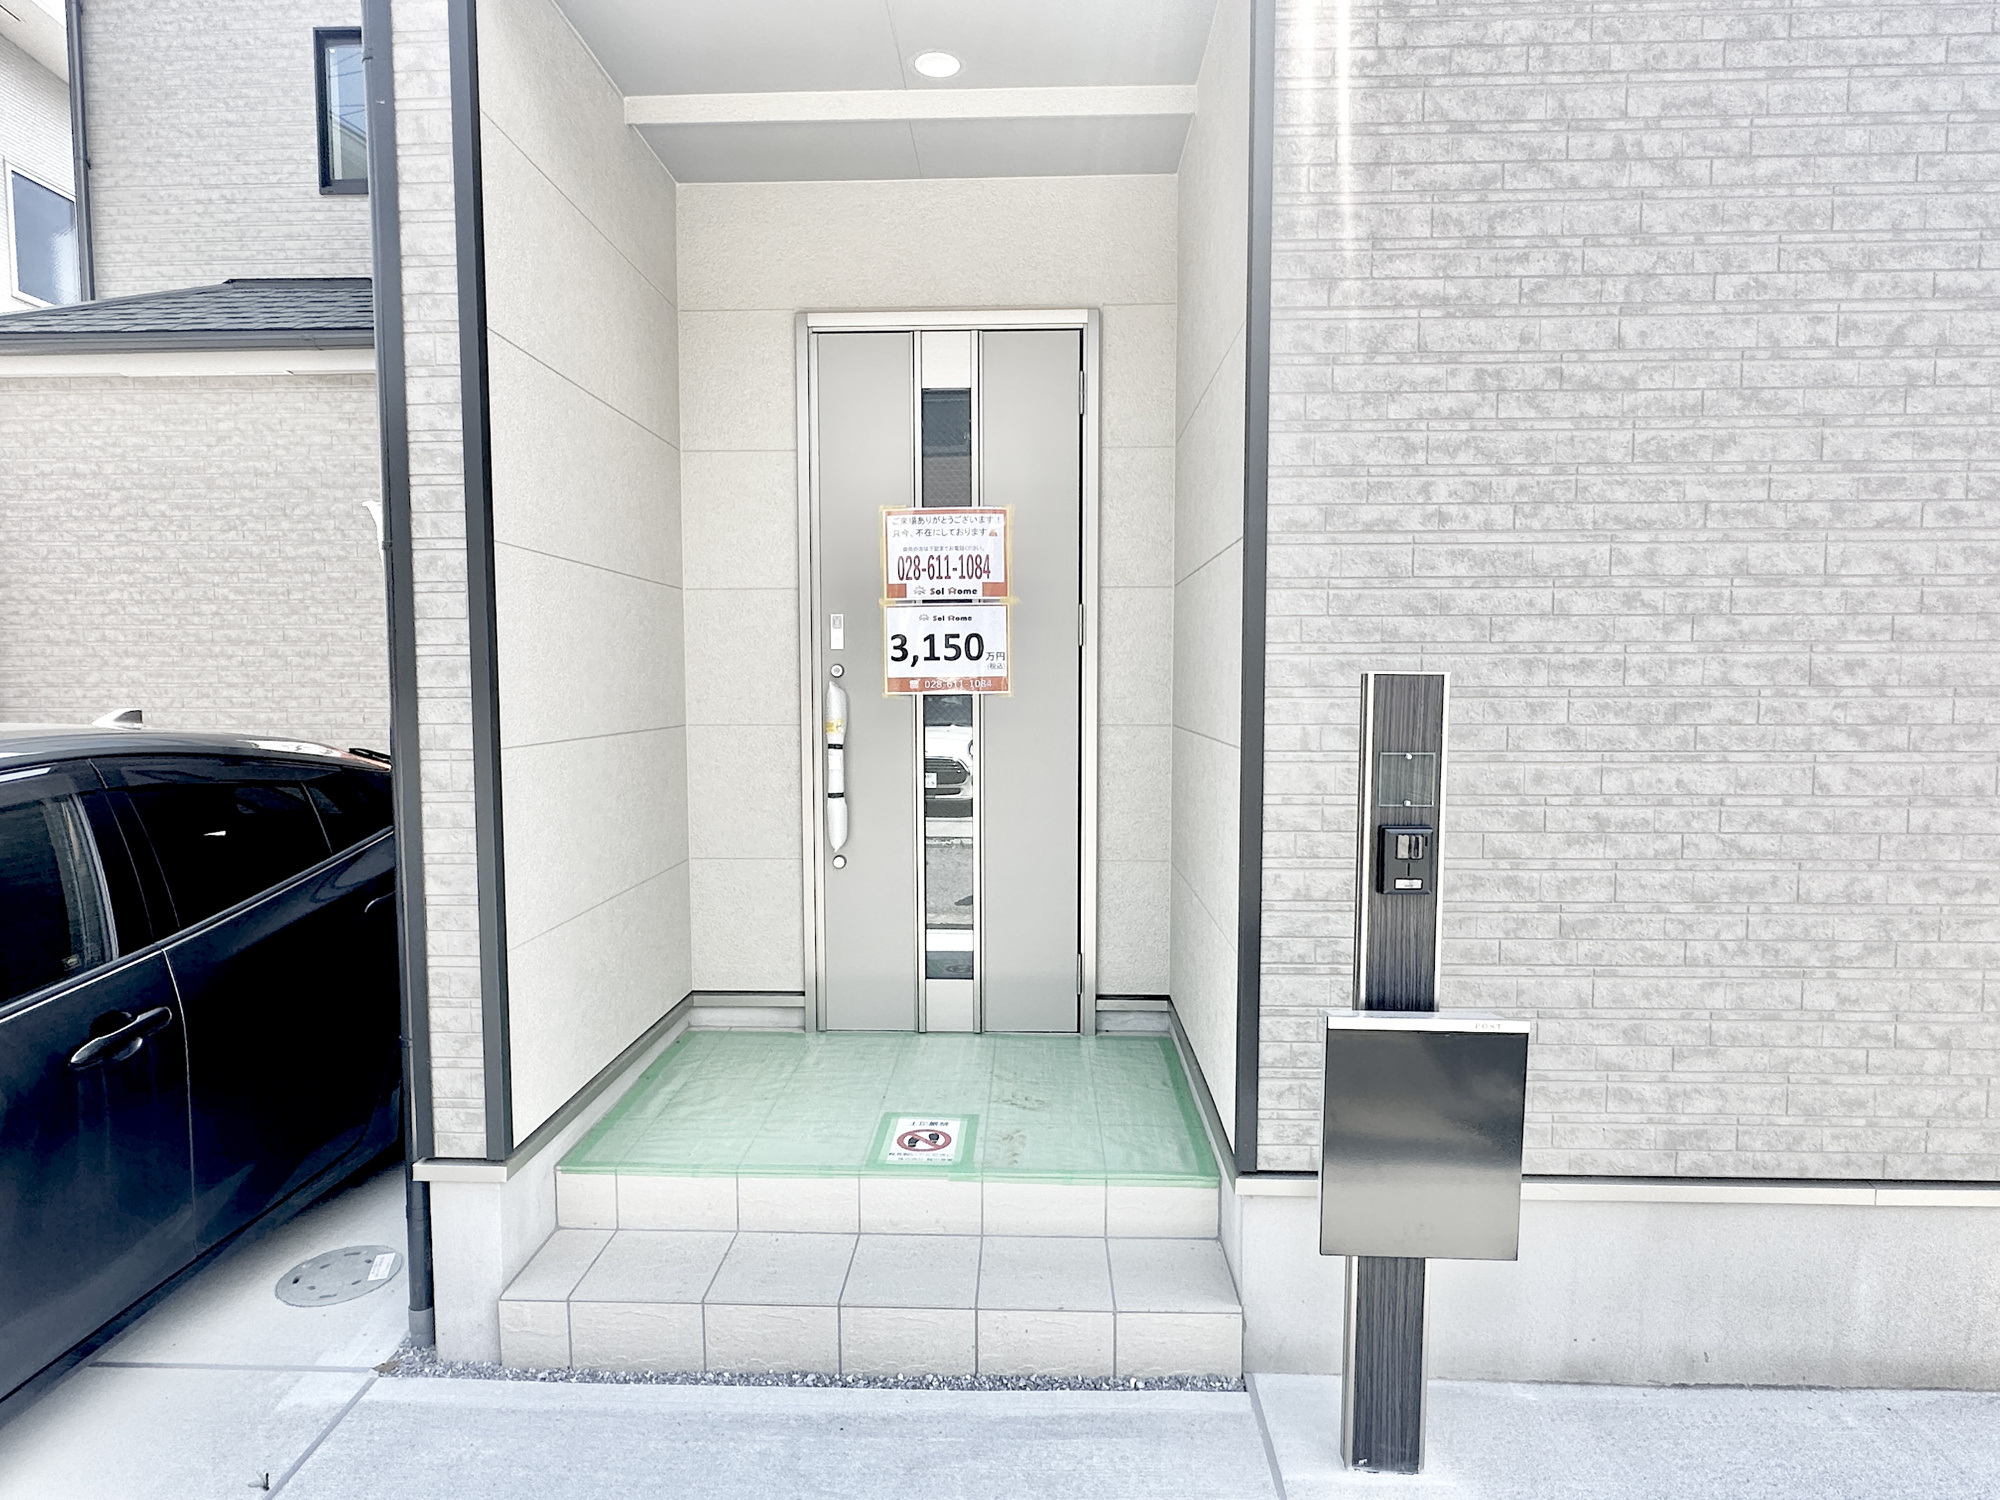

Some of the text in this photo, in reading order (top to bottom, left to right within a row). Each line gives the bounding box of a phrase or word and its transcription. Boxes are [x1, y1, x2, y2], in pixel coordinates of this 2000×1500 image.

[892, 528, 987, 537] 只今、不在にしております
[897, 554, 991, 581] 028-611-1084
[930, 587, 945, 596] Sol
[890, 632, 1006, 668] 3,150 万円
[924, 679, 992, 689] 028-611-1084
